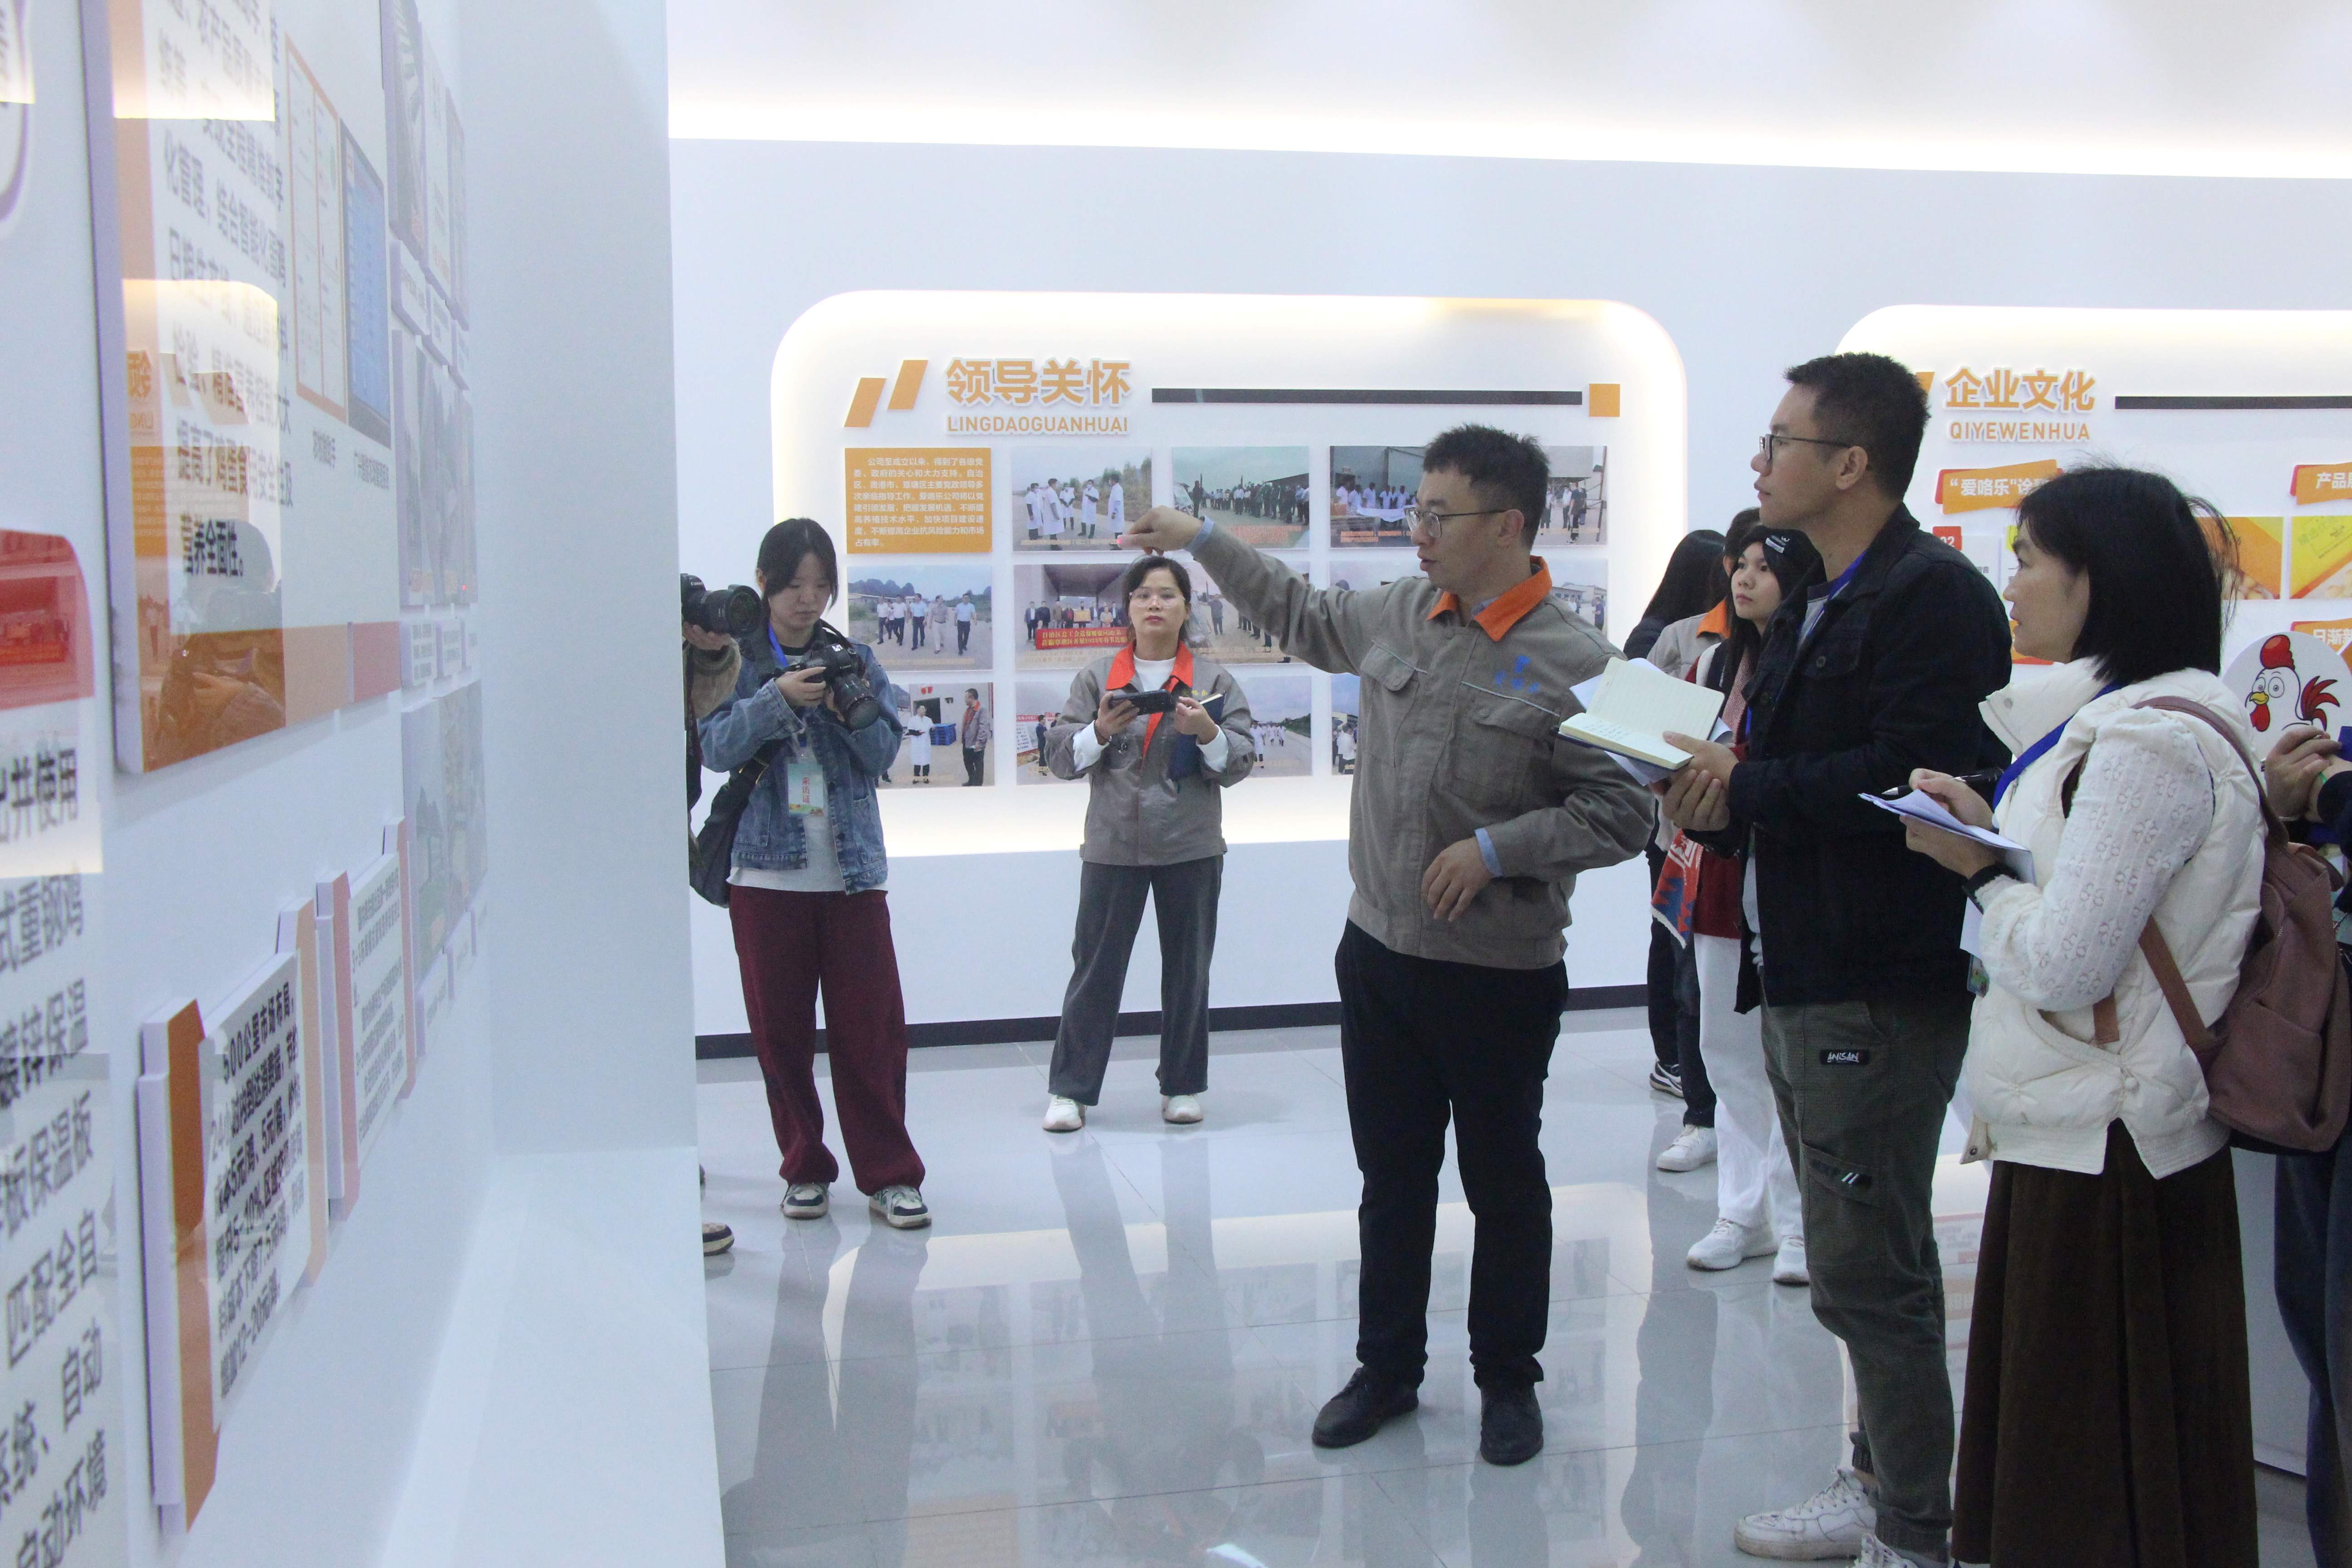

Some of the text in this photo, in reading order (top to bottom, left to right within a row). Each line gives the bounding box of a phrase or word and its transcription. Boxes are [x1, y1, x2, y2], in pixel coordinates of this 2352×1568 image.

[947, 360, 1130, 404] 领导关怀
[1945, 368, 2095, 411] 企业文化
[948, 416, 1127, 432] LINGDAOGUANHUAI
[1950, 422, 2090, 439] QIYEWENHUA
[180, 512, 243, 577] 营养全面性。
[7, 1208, 98, 1369] 匹配全自
